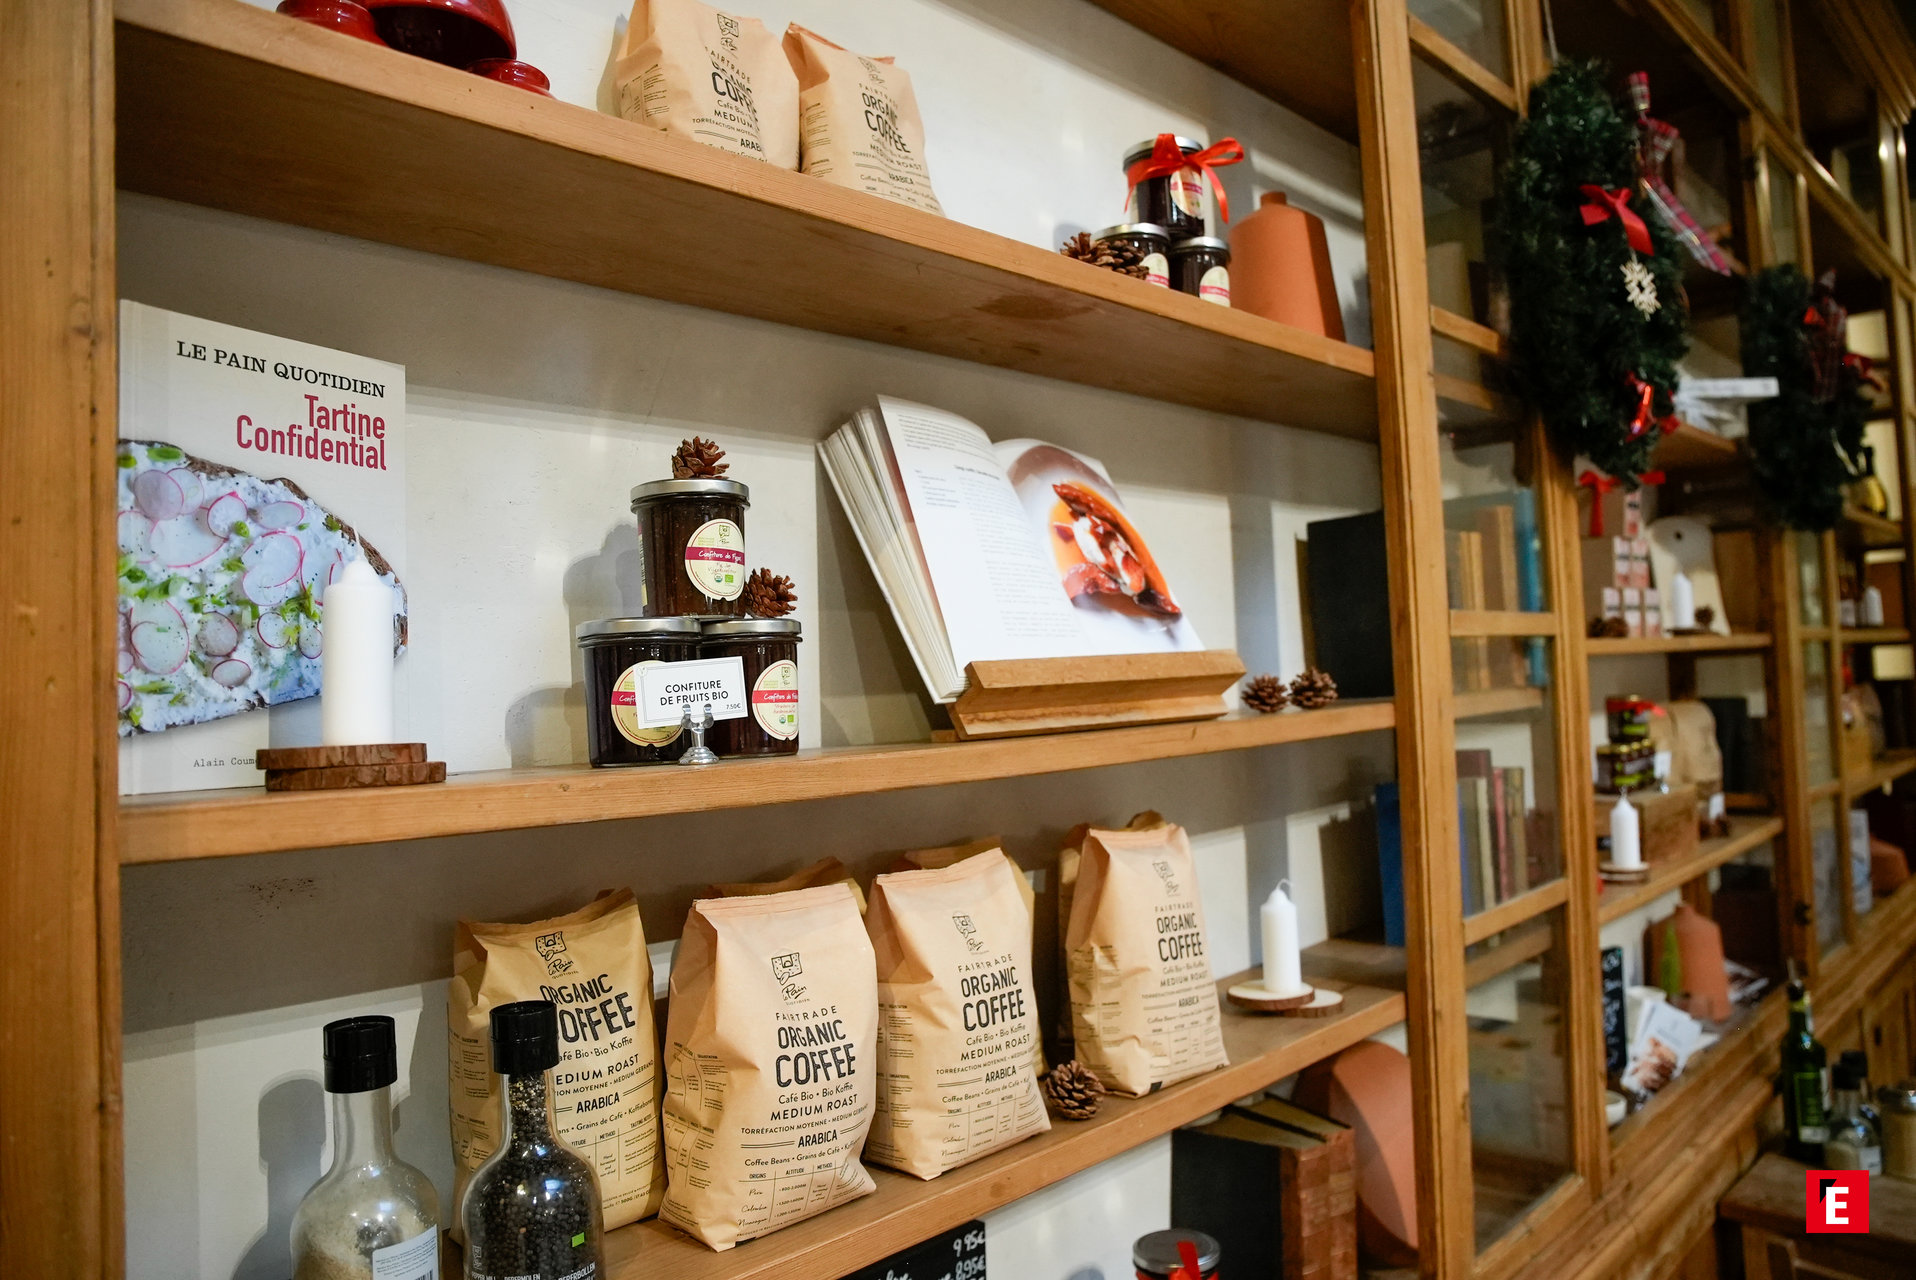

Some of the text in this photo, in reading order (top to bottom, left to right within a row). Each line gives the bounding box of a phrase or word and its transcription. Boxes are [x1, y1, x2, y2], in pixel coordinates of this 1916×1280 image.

[864, 109, 911, 153] COFFEE
[740, 138, 762, 152] ARAB
[176, 340, 386, 398] LE PAIN QUOTIDIEN
[304, 394, 386, 439] Tartine
[236, 414, 387, 471] Confidential
[660, 690, 729, 706] DE FRUITS BIO
[665, 679, 722, 694] CONFITURE
[193, 757, 225, 768] Alain
[1156, 912, 1197, 934] ORGANIC
[1158, 932, 1203, 962] COFFEE
[957, 953, 1013, 972] FAIRTRADE
[539, 973, 613, 1005] ORGANIC
[782, 983, 807, 999] Pain
[960, 966, 1019, 998] ORGANIC
[559, 991, 636, 1043] OFFEE
[775, 1005, 837, 1021] FAIRTRADE
[962, 988, 1026, 1032] COFFEE
[777, 1019, 847, 1049] ORGANIC
[966, 1035, 982, 1046] Café
[983, 1033, 994, 1042] Bio
[999, 1029, 1009, 1038] Bio
[559, 1036, 633, 1062] afé Bio Bio Koffie
[960, 1033, 1031, 1061] MEDIUM ROAST
[556, 1053, 639, 1086] EDIUM ROAST
[775, 1043, 856, 1088] COFFEE
[984, 1065, 1017, 1084] ARABICA
[572, 1081, 608, 1094] MOYENNE
[613, 1071, 635, 1084] MEDIUM
[778, 1081, 853, 1105] Café Bio Bio Koffie
[576, 1092, 620, 1114] ARABICA
[770, 1094, 858, 1121] MEDIUM ROAST
[942, 1095, 963, 1104] Coffee
[576, 1121, 599, 1131] Grains
[600, 1118, 608, 1126] de
[609, 1111, 624, 1122] Café
[741, 1124, 795, 1135] TORRÉFACTION
[796, 1119, 827, 1130] MOYENNE
[831, 1112, 853, 1123] MEDIUM
[571, 1138, 587, 1146] TITUDE
[797, 1129, 838, 1149] ARABICA
[744, 1158, 769, 1167] Coffee
[770, 1157, 791, 1165] Beans
[796, 1152, 817, 1161] Grains
[818, 1150, 826, 1158] de
[826, 1145, 840, 1156] Café
[786, 1167, 805, 1176] ALTITUDE
